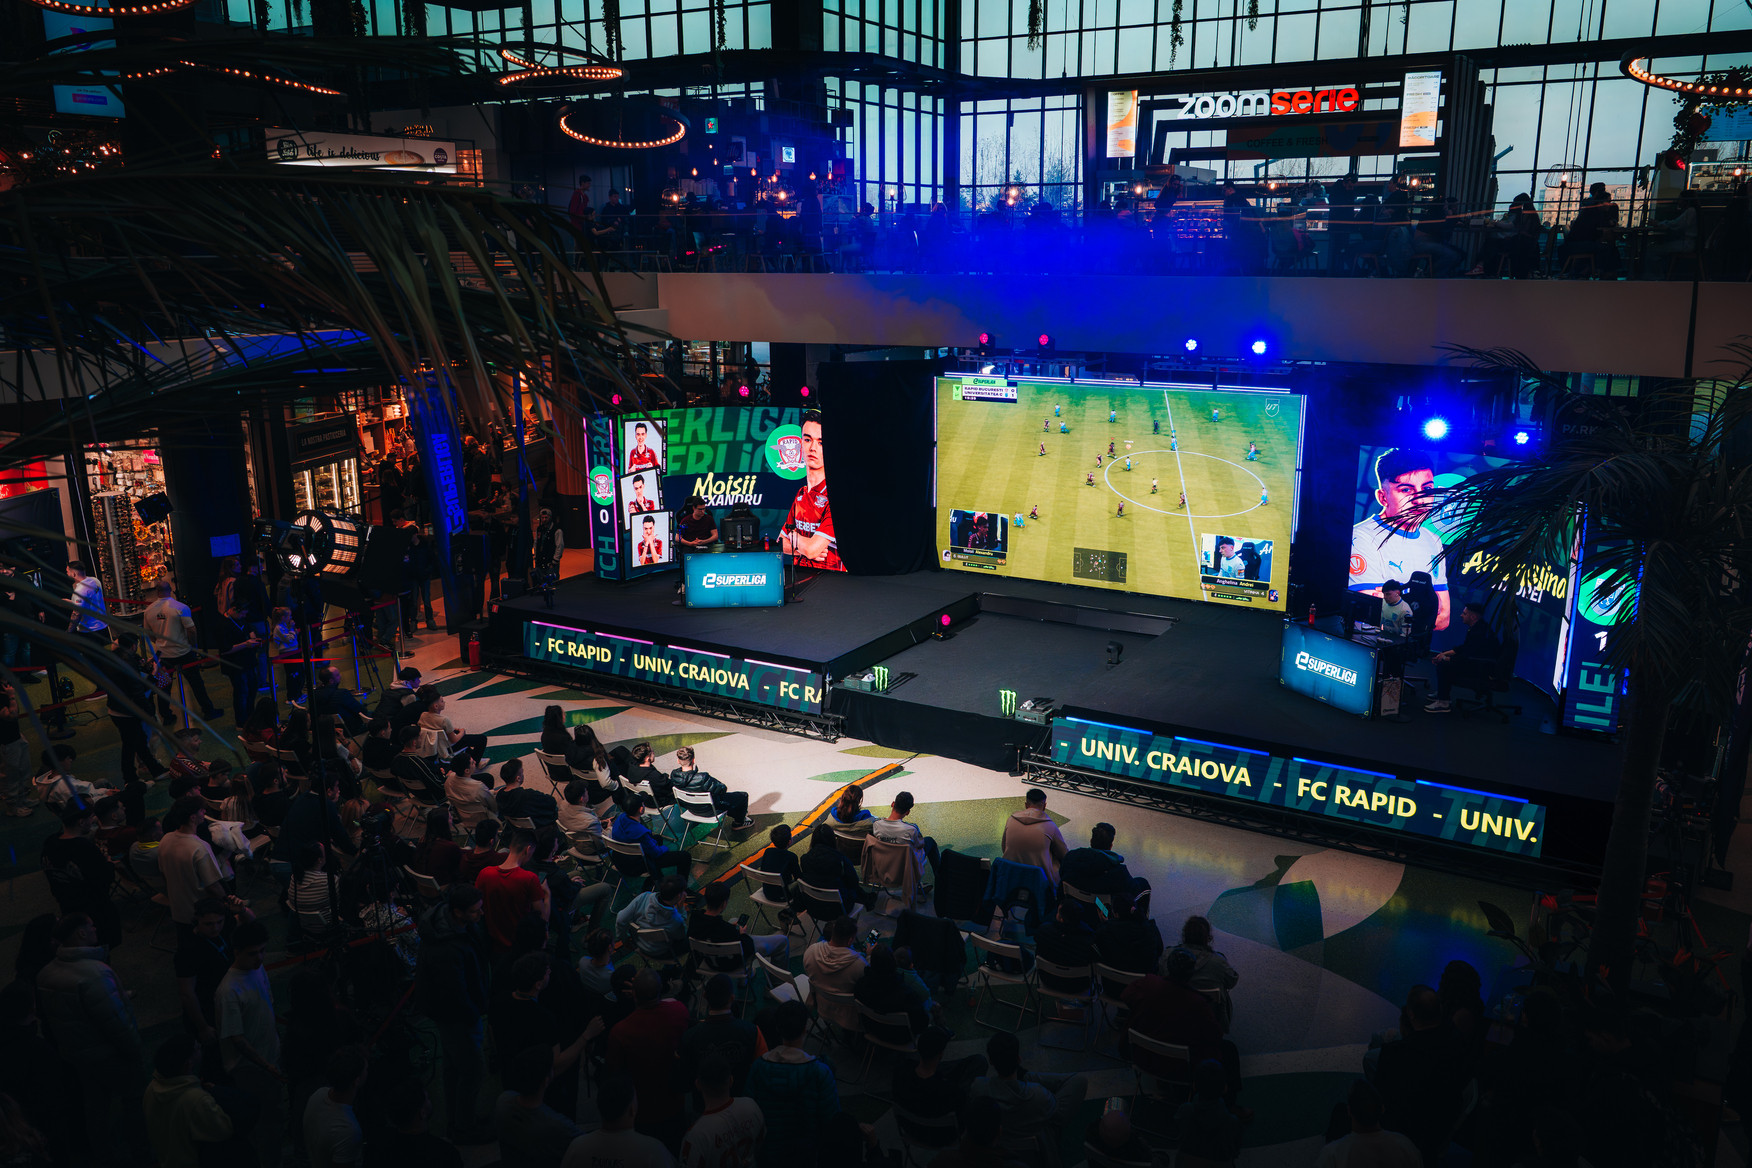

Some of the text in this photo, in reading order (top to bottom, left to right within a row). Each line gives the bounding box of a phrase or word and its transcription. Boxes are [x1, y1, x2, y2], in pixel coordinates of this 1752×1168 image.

[1177, 88, 1359, 119] zoomserie
[306, 144, 323, 157] life
[340, 146, 380, 161] delicious
[1246, 136, 1328, 148] COFFEE & FRESH
[692, 472, 757, 500] Moisii
[702, 494, 762, 506] EXANDRU
[600, 509, 609, 523] 0
[548, 637, 564, 654] FC
[568, 641, 611, 663] RAPID
[634, 653, 675, 676] UNIV.
[678, 662, 750, 690] CRAIOVA
[780, 681, 799, 700] FC
[1081, 737, 1139, 766] UNIV.
[1146, 751, 1252, 787] CRAIOVA
[1297, 778, 1327, 801] FC
[1334, 785, 1417, 818] RAPID
[1460, 808, 1538, 843] UNIV.
